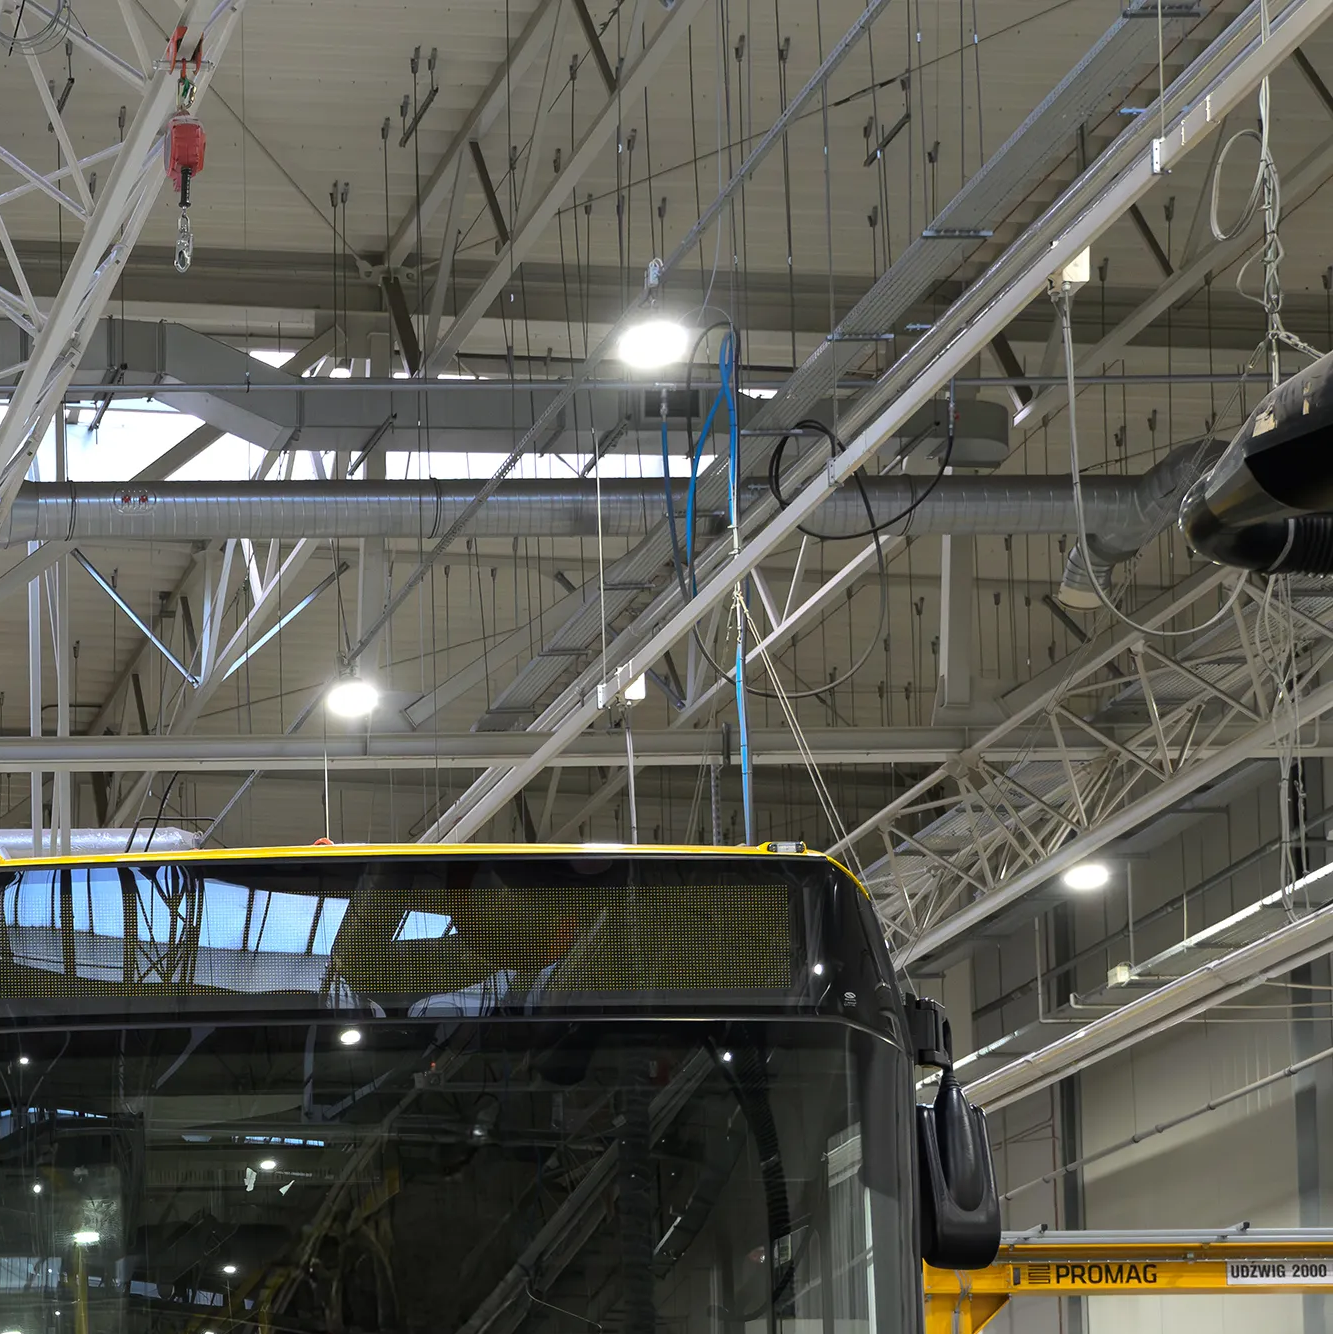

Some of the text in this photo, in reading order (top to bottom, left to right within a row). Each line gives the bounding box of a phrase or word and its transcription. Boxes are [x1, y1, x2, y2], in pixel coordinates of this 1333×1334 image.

[1055, 1264, 1158, 1284] PROMAG
[1230, 1260, 1328, 1279] UDŹWIG 2000
